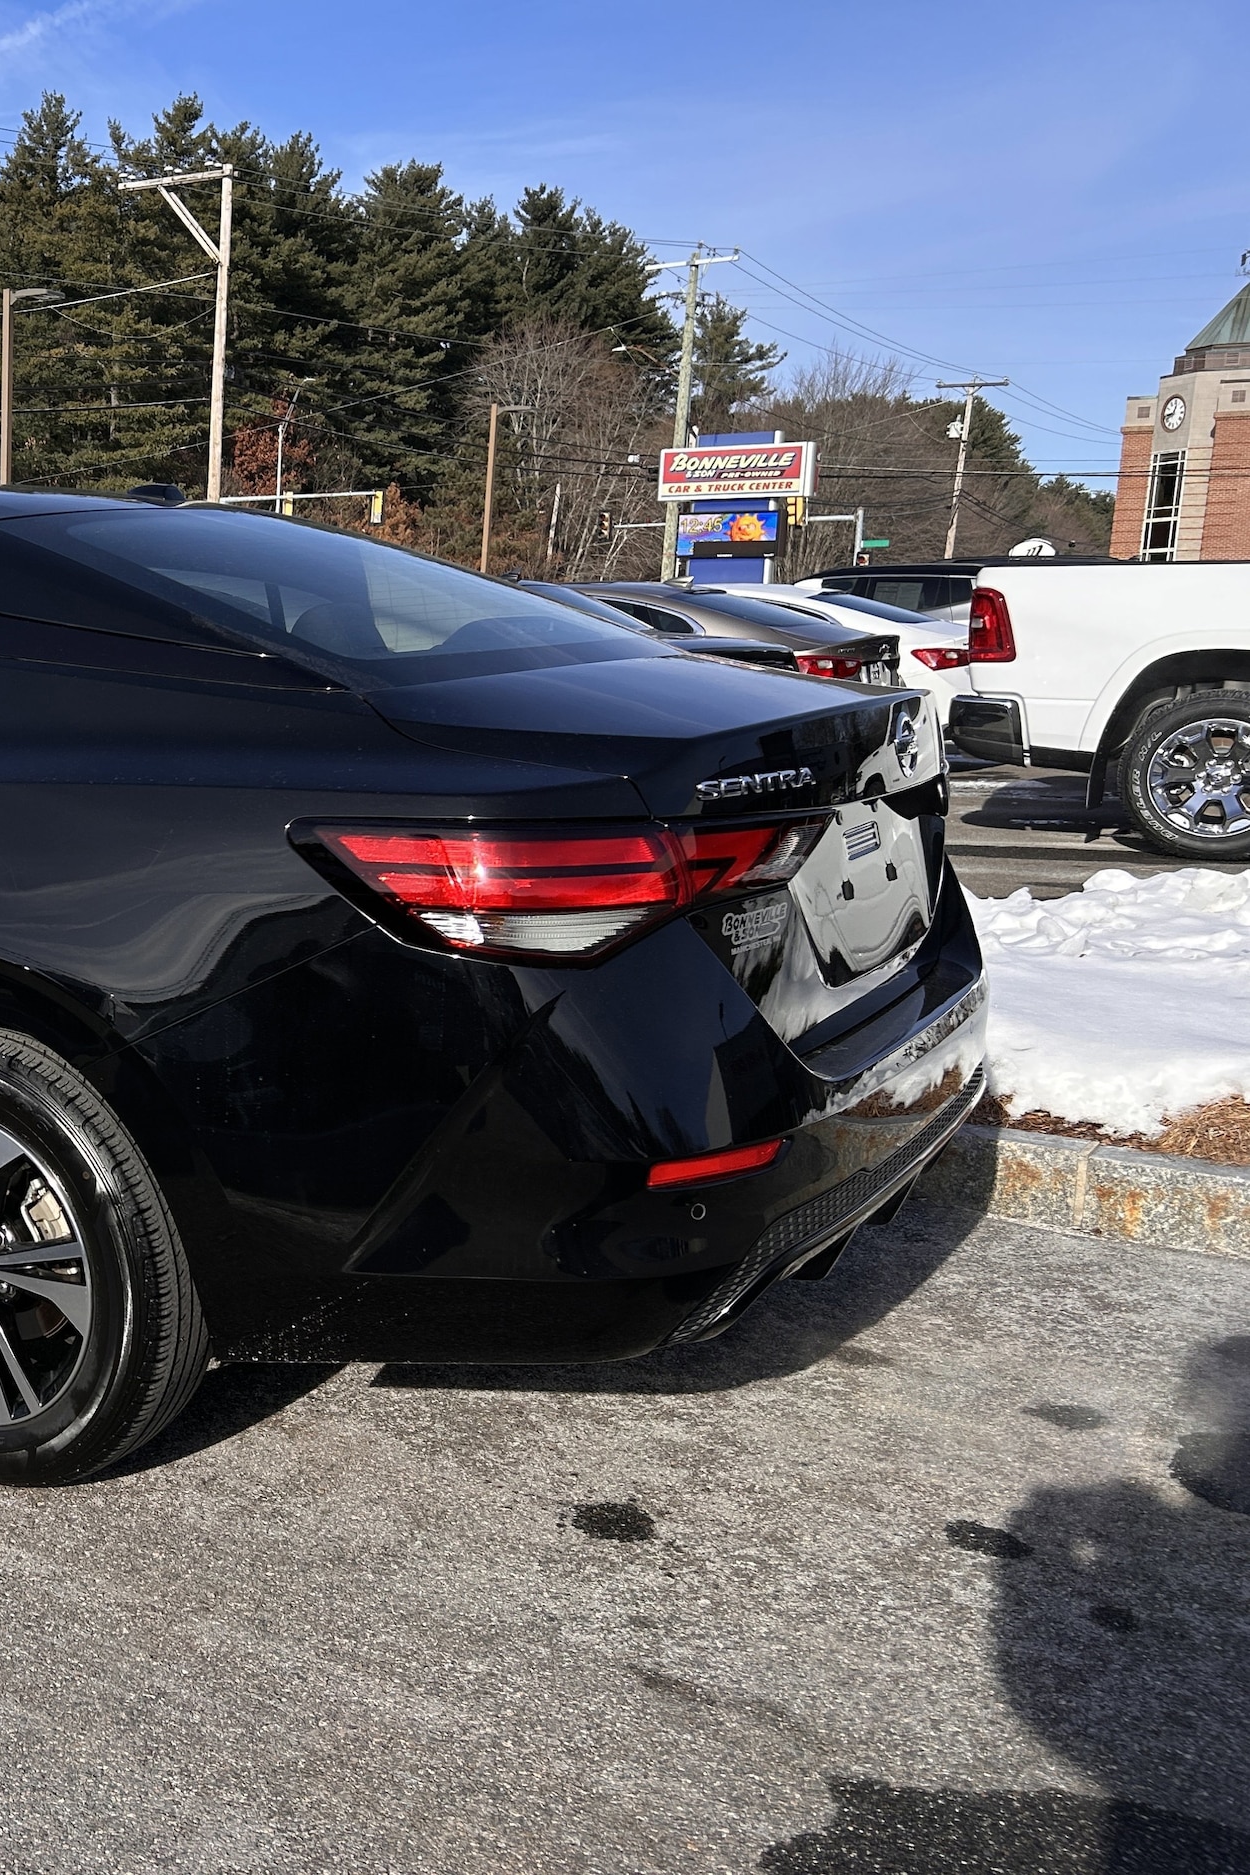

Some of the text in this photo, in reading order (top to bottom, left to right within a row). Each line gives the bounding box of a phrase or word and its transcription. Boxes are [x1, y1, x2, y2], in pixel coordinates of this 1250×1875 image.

[669, 452, 796, 472] BONNEVILLE
[693, 470, 716, 478] SON
[721, 471, 781, 479] PRE-OWNED
[668, 481, 794, 494] CAR & TRUCK CENTER
[681, 517, 723, 535] 12:45
[695, 767, 817, 801] SENTRA
[723, 903, 787, 935] BONNEVILLE
[742, 925, 759, 940] SON
